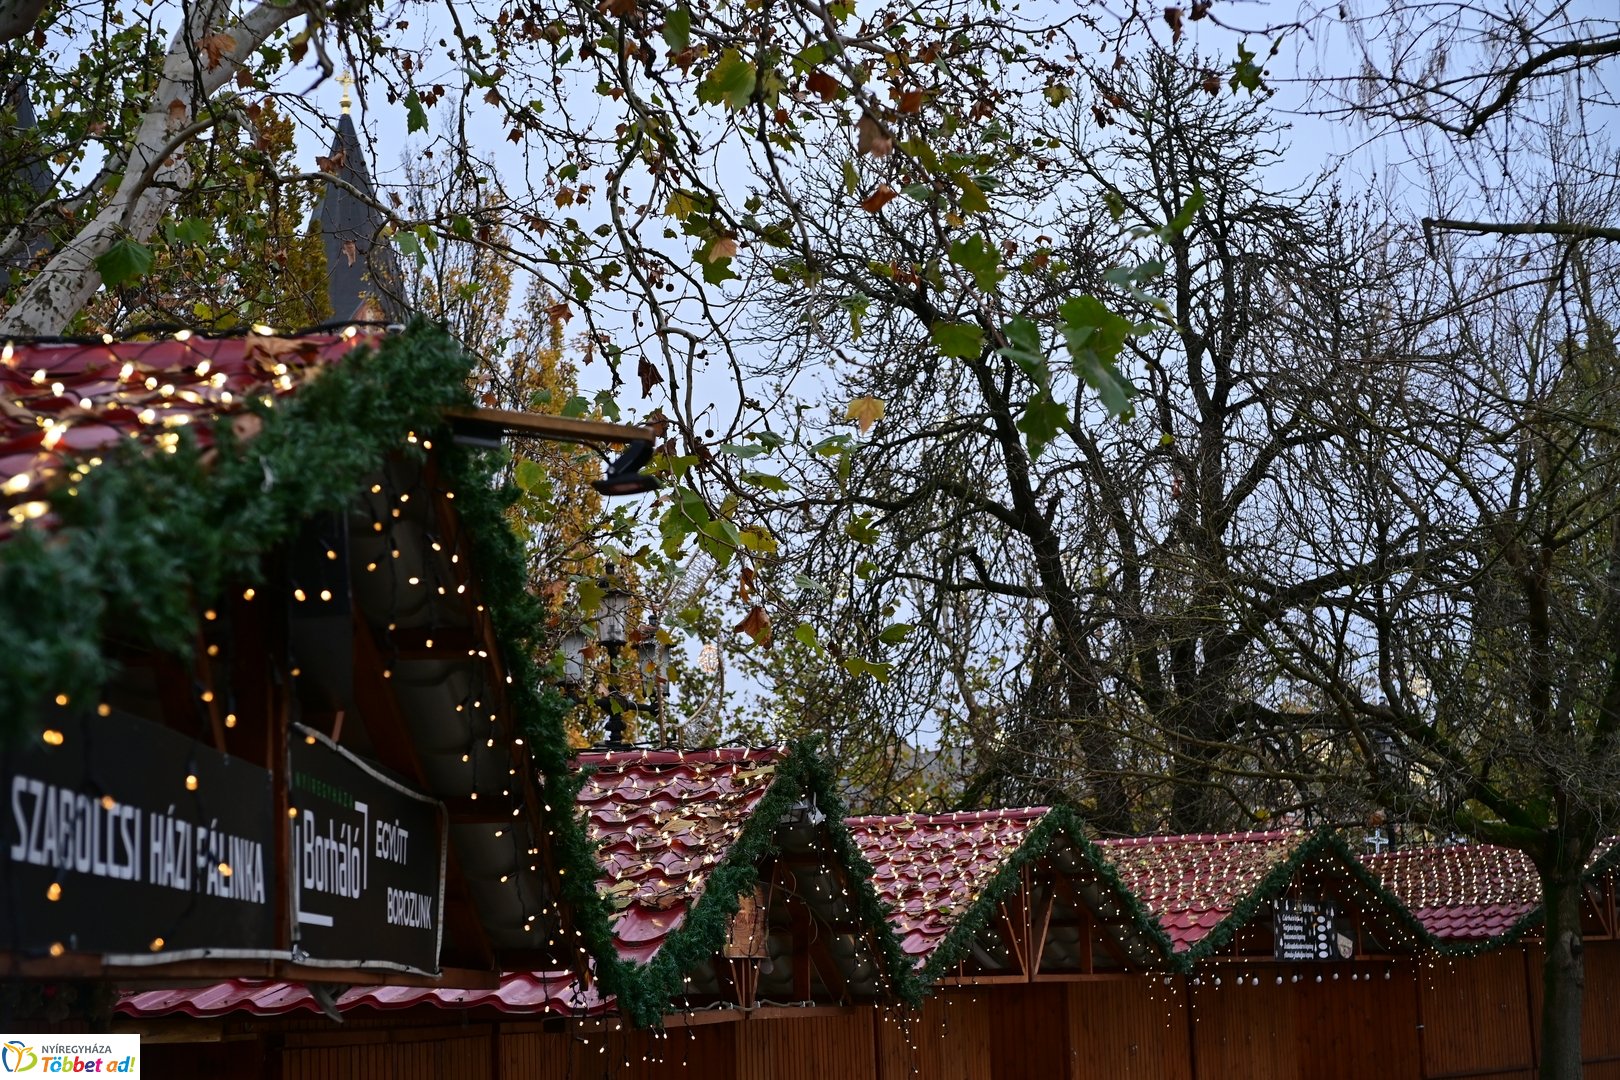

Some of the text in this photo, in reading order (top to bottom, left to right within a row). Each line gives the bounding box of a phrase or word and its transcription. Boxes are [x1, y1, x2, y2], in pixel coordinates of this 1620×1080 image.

[11, 775, 265, 904] SZABOLCSI HÁZI PÁLINKA
[303, 809, 360, 899] Borháló
[375, 819, 408, 865] EGYÜTT
[387, 886, 432, 930] BOROZUNK
